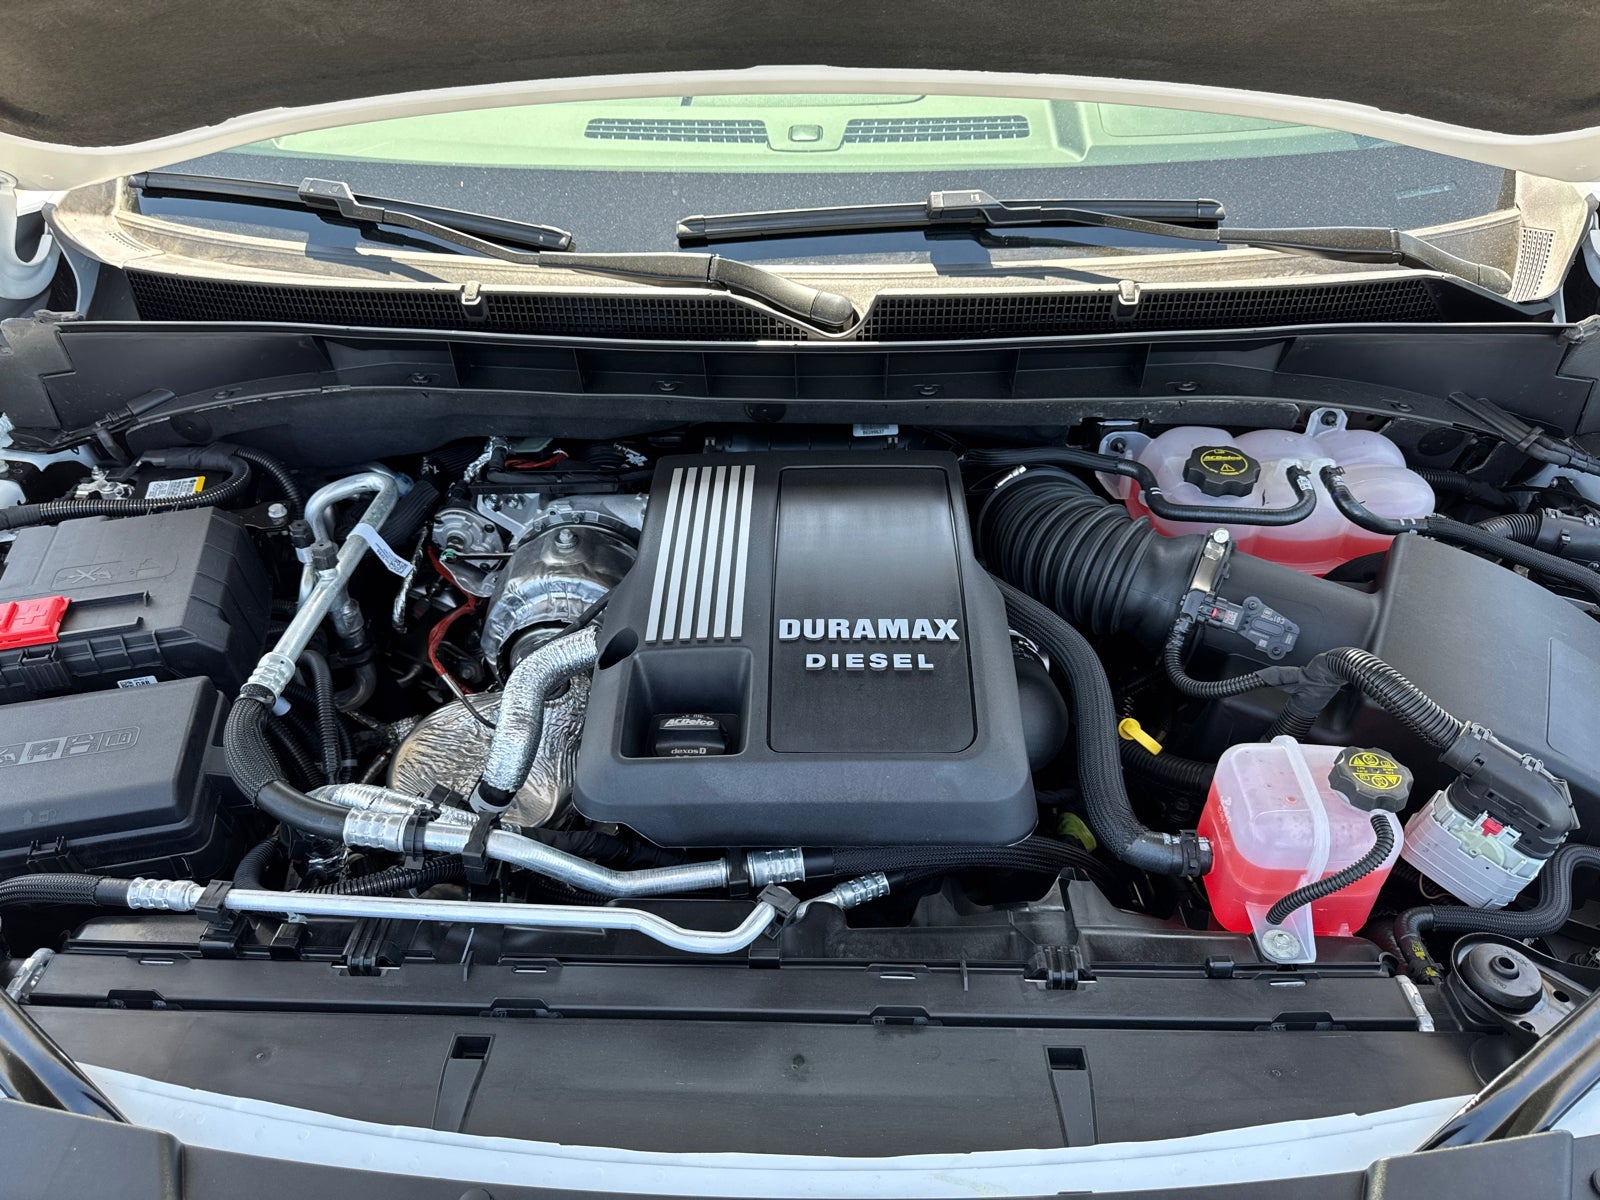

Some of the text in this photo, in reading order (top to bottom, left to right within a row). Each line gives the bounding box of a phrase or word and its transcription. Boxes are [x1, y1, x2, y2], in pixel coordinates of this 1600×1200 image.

[779, 618, 960, 640] DURAMAX
[805, 653, 934, 670] DIESEL
[663, 718, 715, 728] ACDelco
